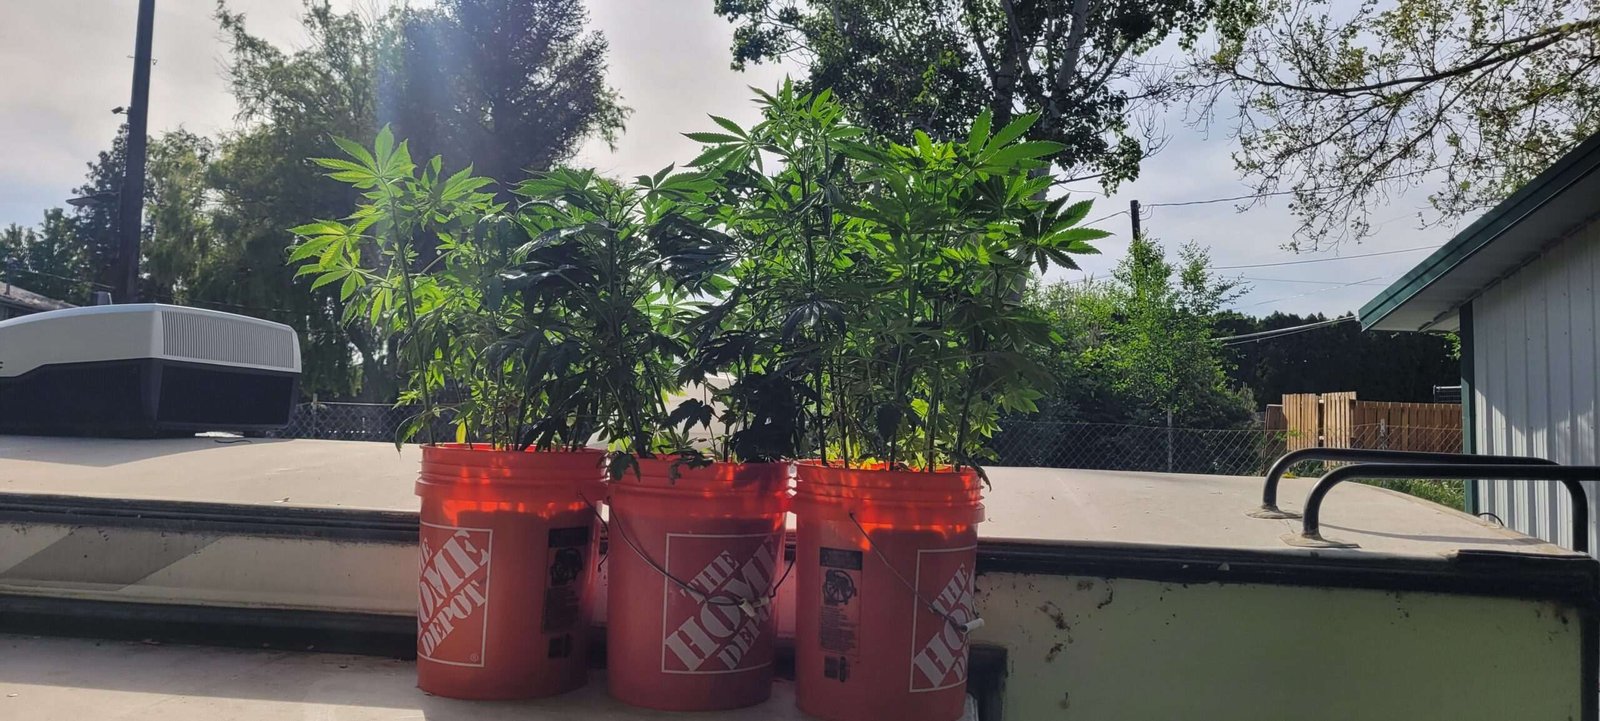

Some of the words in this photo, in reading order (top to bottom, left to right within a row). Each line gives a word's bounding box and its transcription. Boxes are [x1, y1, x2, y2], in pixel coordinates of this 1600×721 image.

[418, 530, 489, 640] OME
[680, 550, 740, 605] THE
[928, 562, 969, 618] THE
[421, 580, 486, 658] DEPOT
[914, 568, 975, 688] HOM
